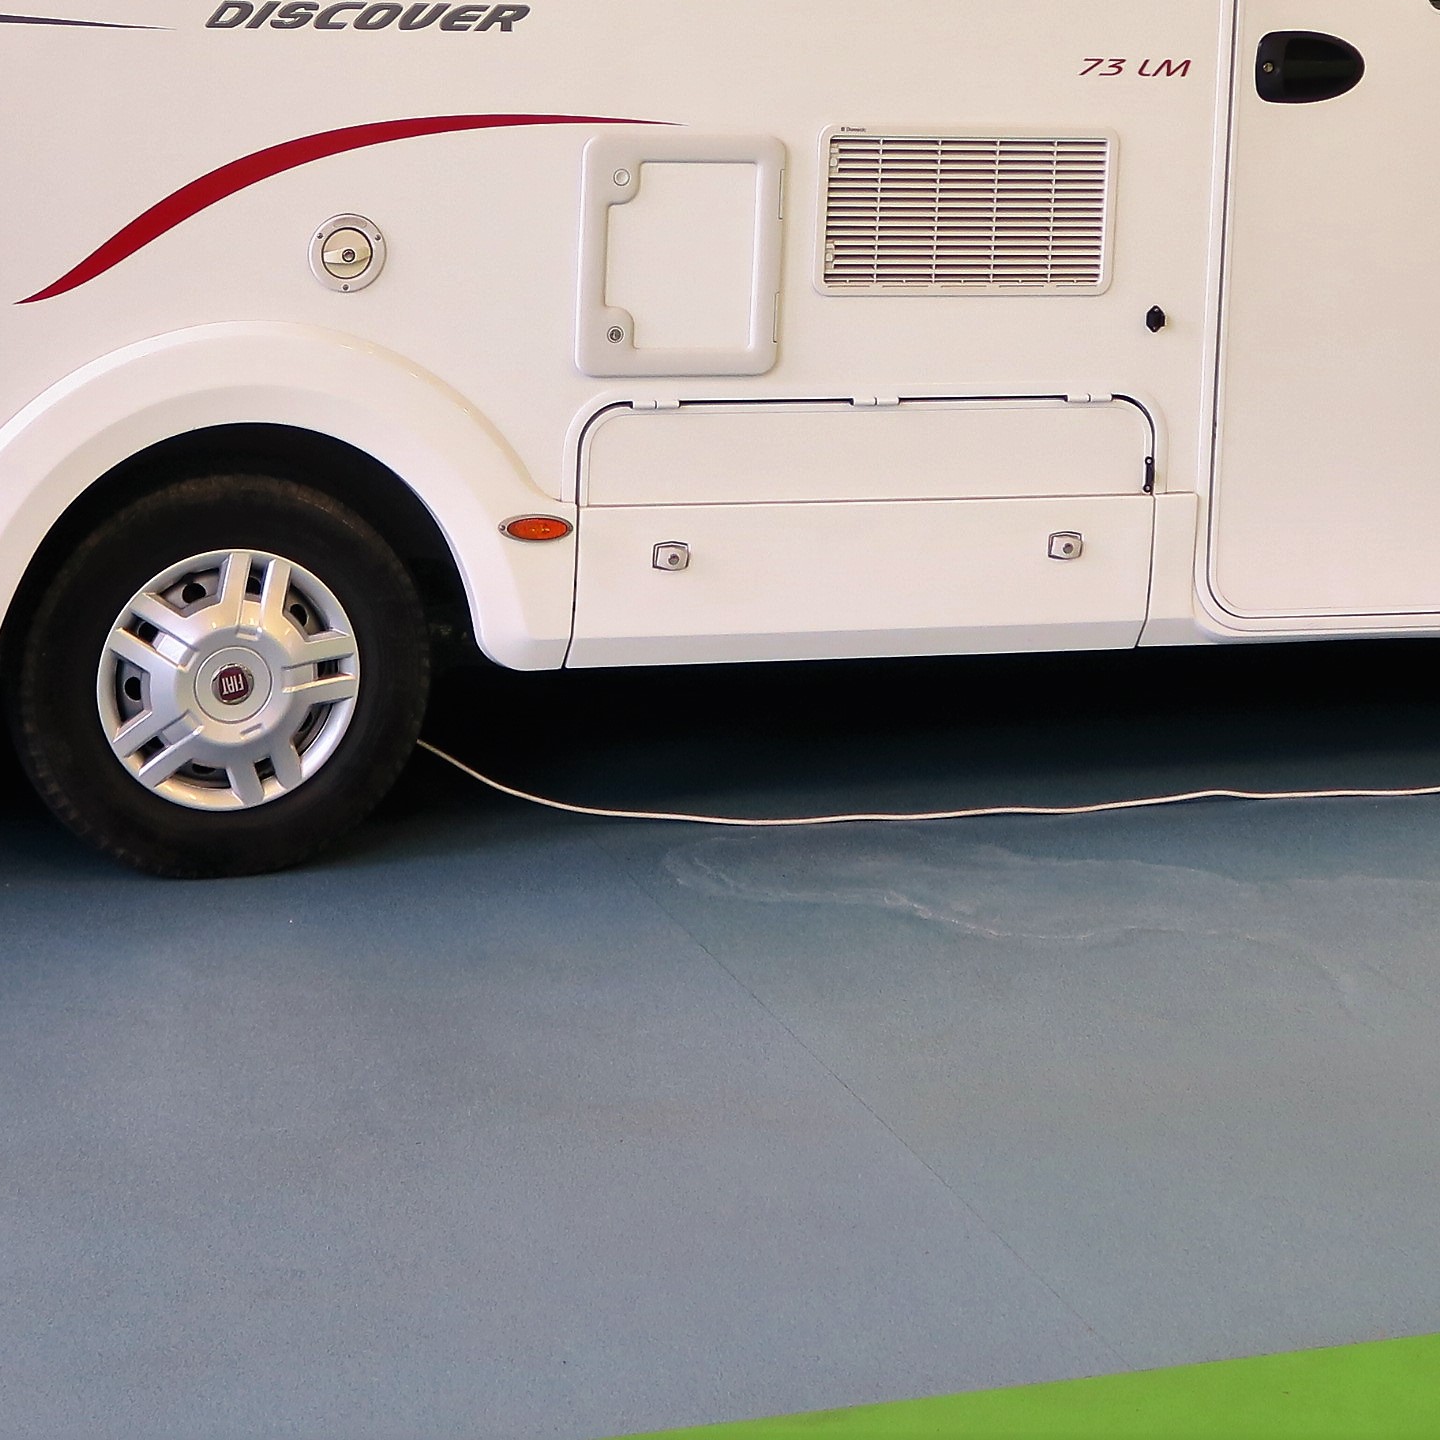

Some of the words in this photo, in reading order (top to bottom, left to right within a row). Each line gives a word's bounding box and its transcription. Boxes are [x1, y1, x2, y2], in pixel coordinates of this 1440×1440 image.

[1078, 58, 1127, 76] 73
[1137, 58, 1192, 77] LM
[221, 673, 245, 695] FIAT
